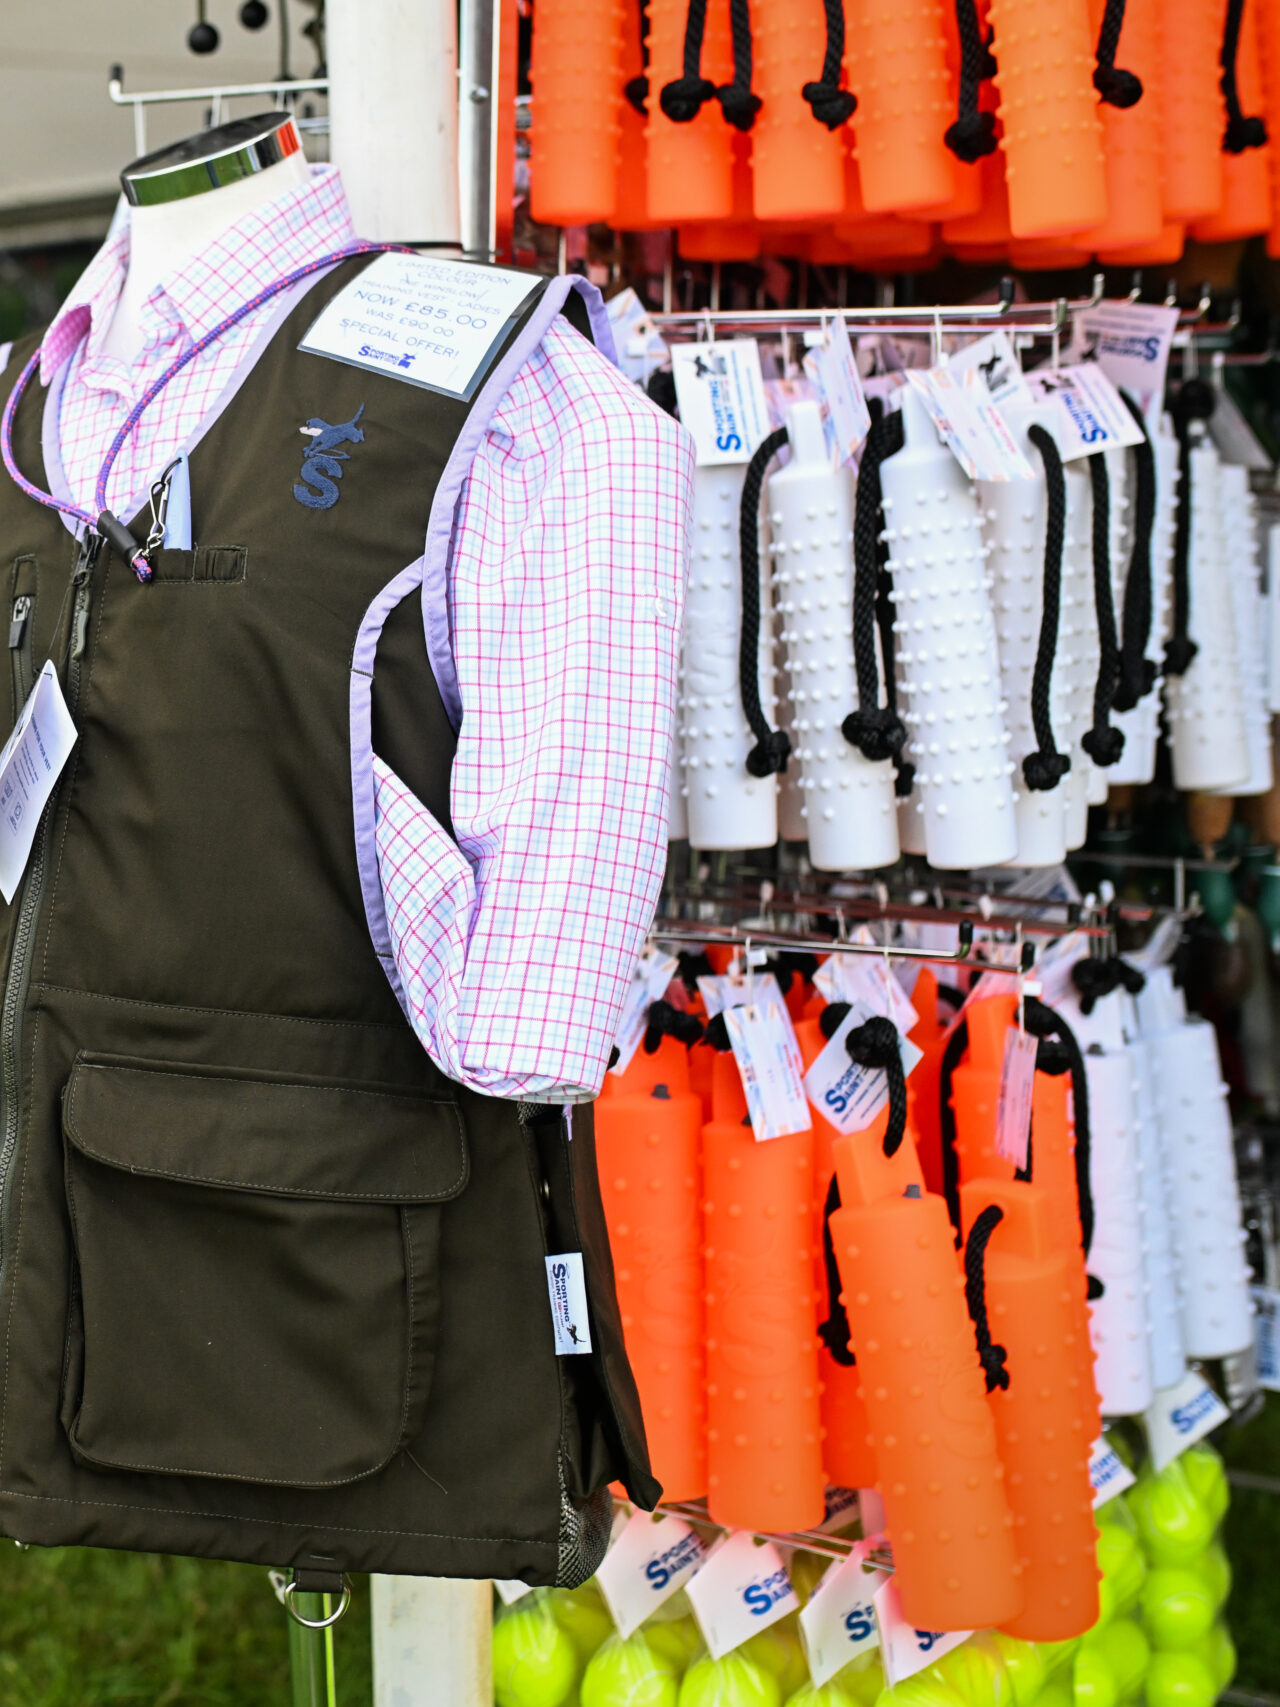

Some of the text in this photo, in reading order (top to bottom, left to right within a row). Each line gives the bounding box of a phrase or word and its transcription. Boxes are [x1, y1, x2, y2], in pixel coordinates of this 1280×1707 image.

[455, 268, 512, 286] EDITION
[353, 290, 487, 330] NOW £85.00
[365, 307, 455, 338] WAS £9000
[457, 300, 501, 316] LADIES
[339, 318, 461, 360] SPECIAL OFFER!
[293, 456, 343, 510] S
[552, 1263, 570, 1323] SPORTING
